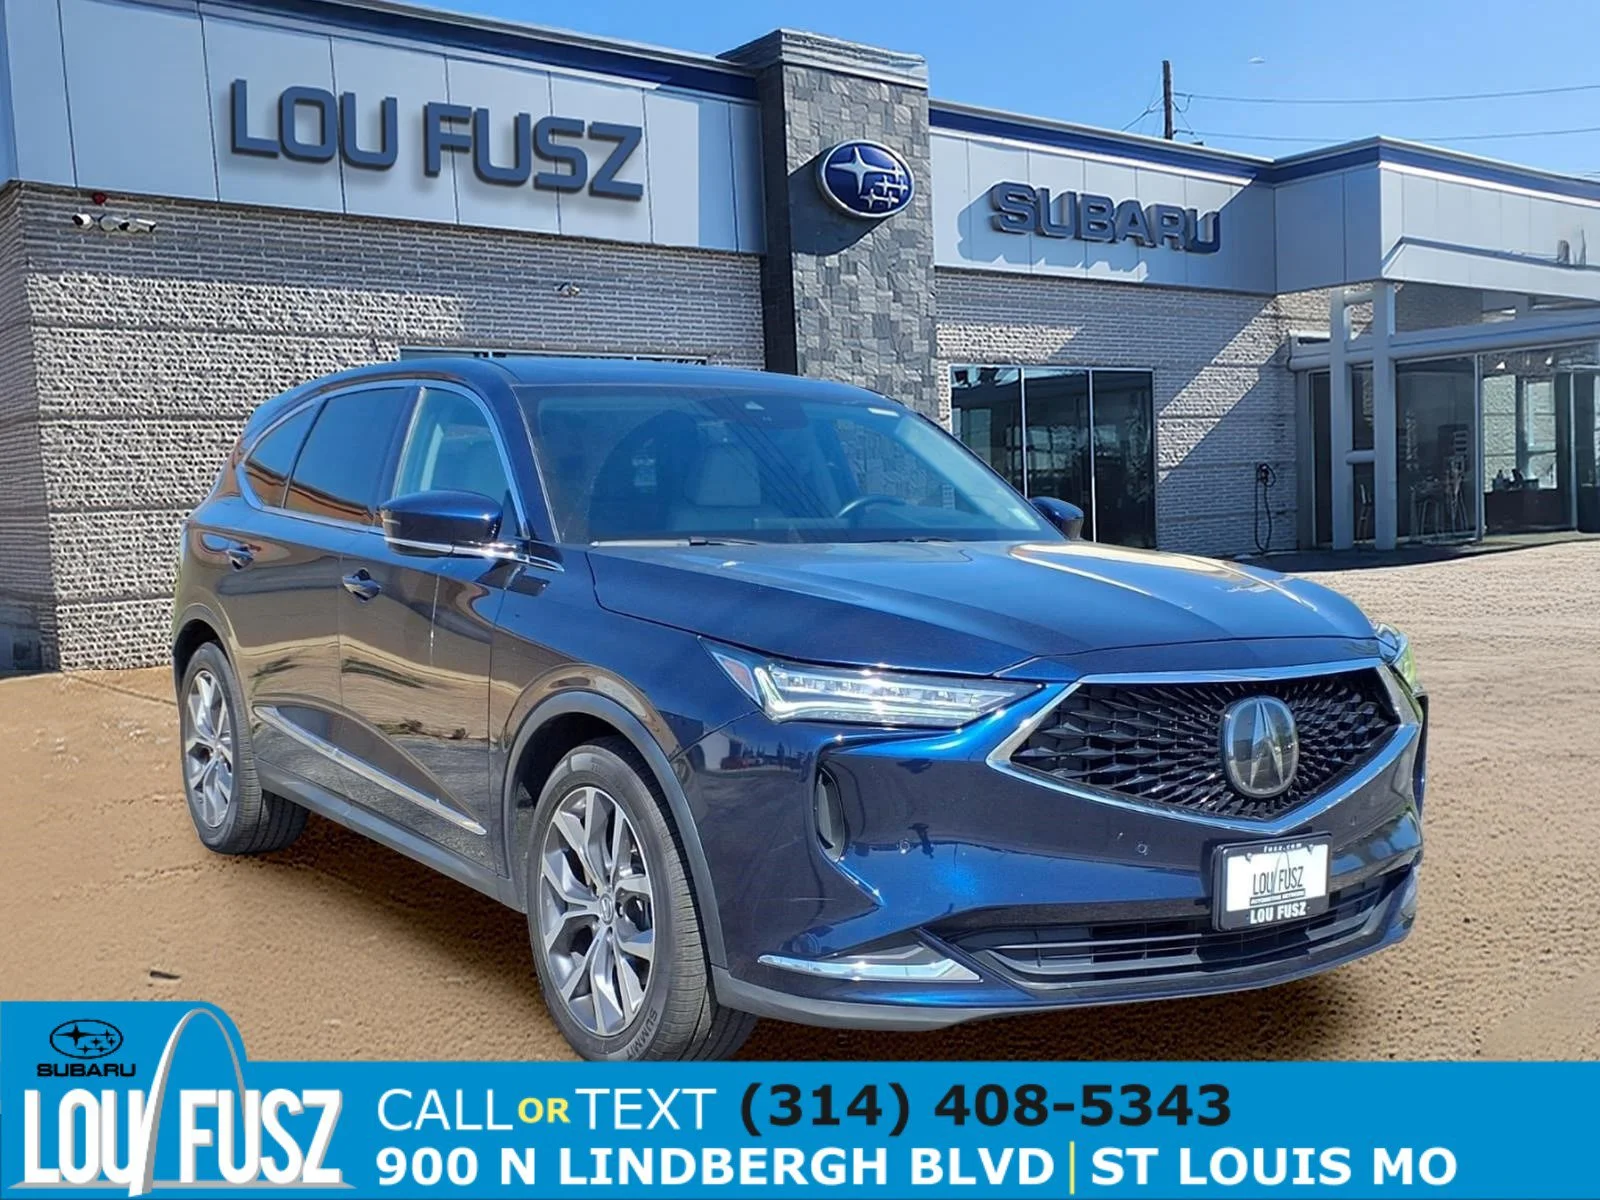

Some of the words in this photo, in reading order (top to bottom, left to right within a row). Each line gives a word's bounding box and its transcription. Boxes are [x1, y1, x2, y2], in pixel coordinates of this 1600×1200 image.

[231, 79, 398, 171] LOU
[424, 101, 643, 200] FUSZ
[990, 181, 1221, 254] SUBARU
[1252, 871, 1274, 896] LOU
[1278, 866, 1304, 891] FUSZ
[1250, 907, 1274, 925] LOU
[1277, 901, 1307, 920] FUSZ
[627, 1009, 658, 1060] SUMMIT
